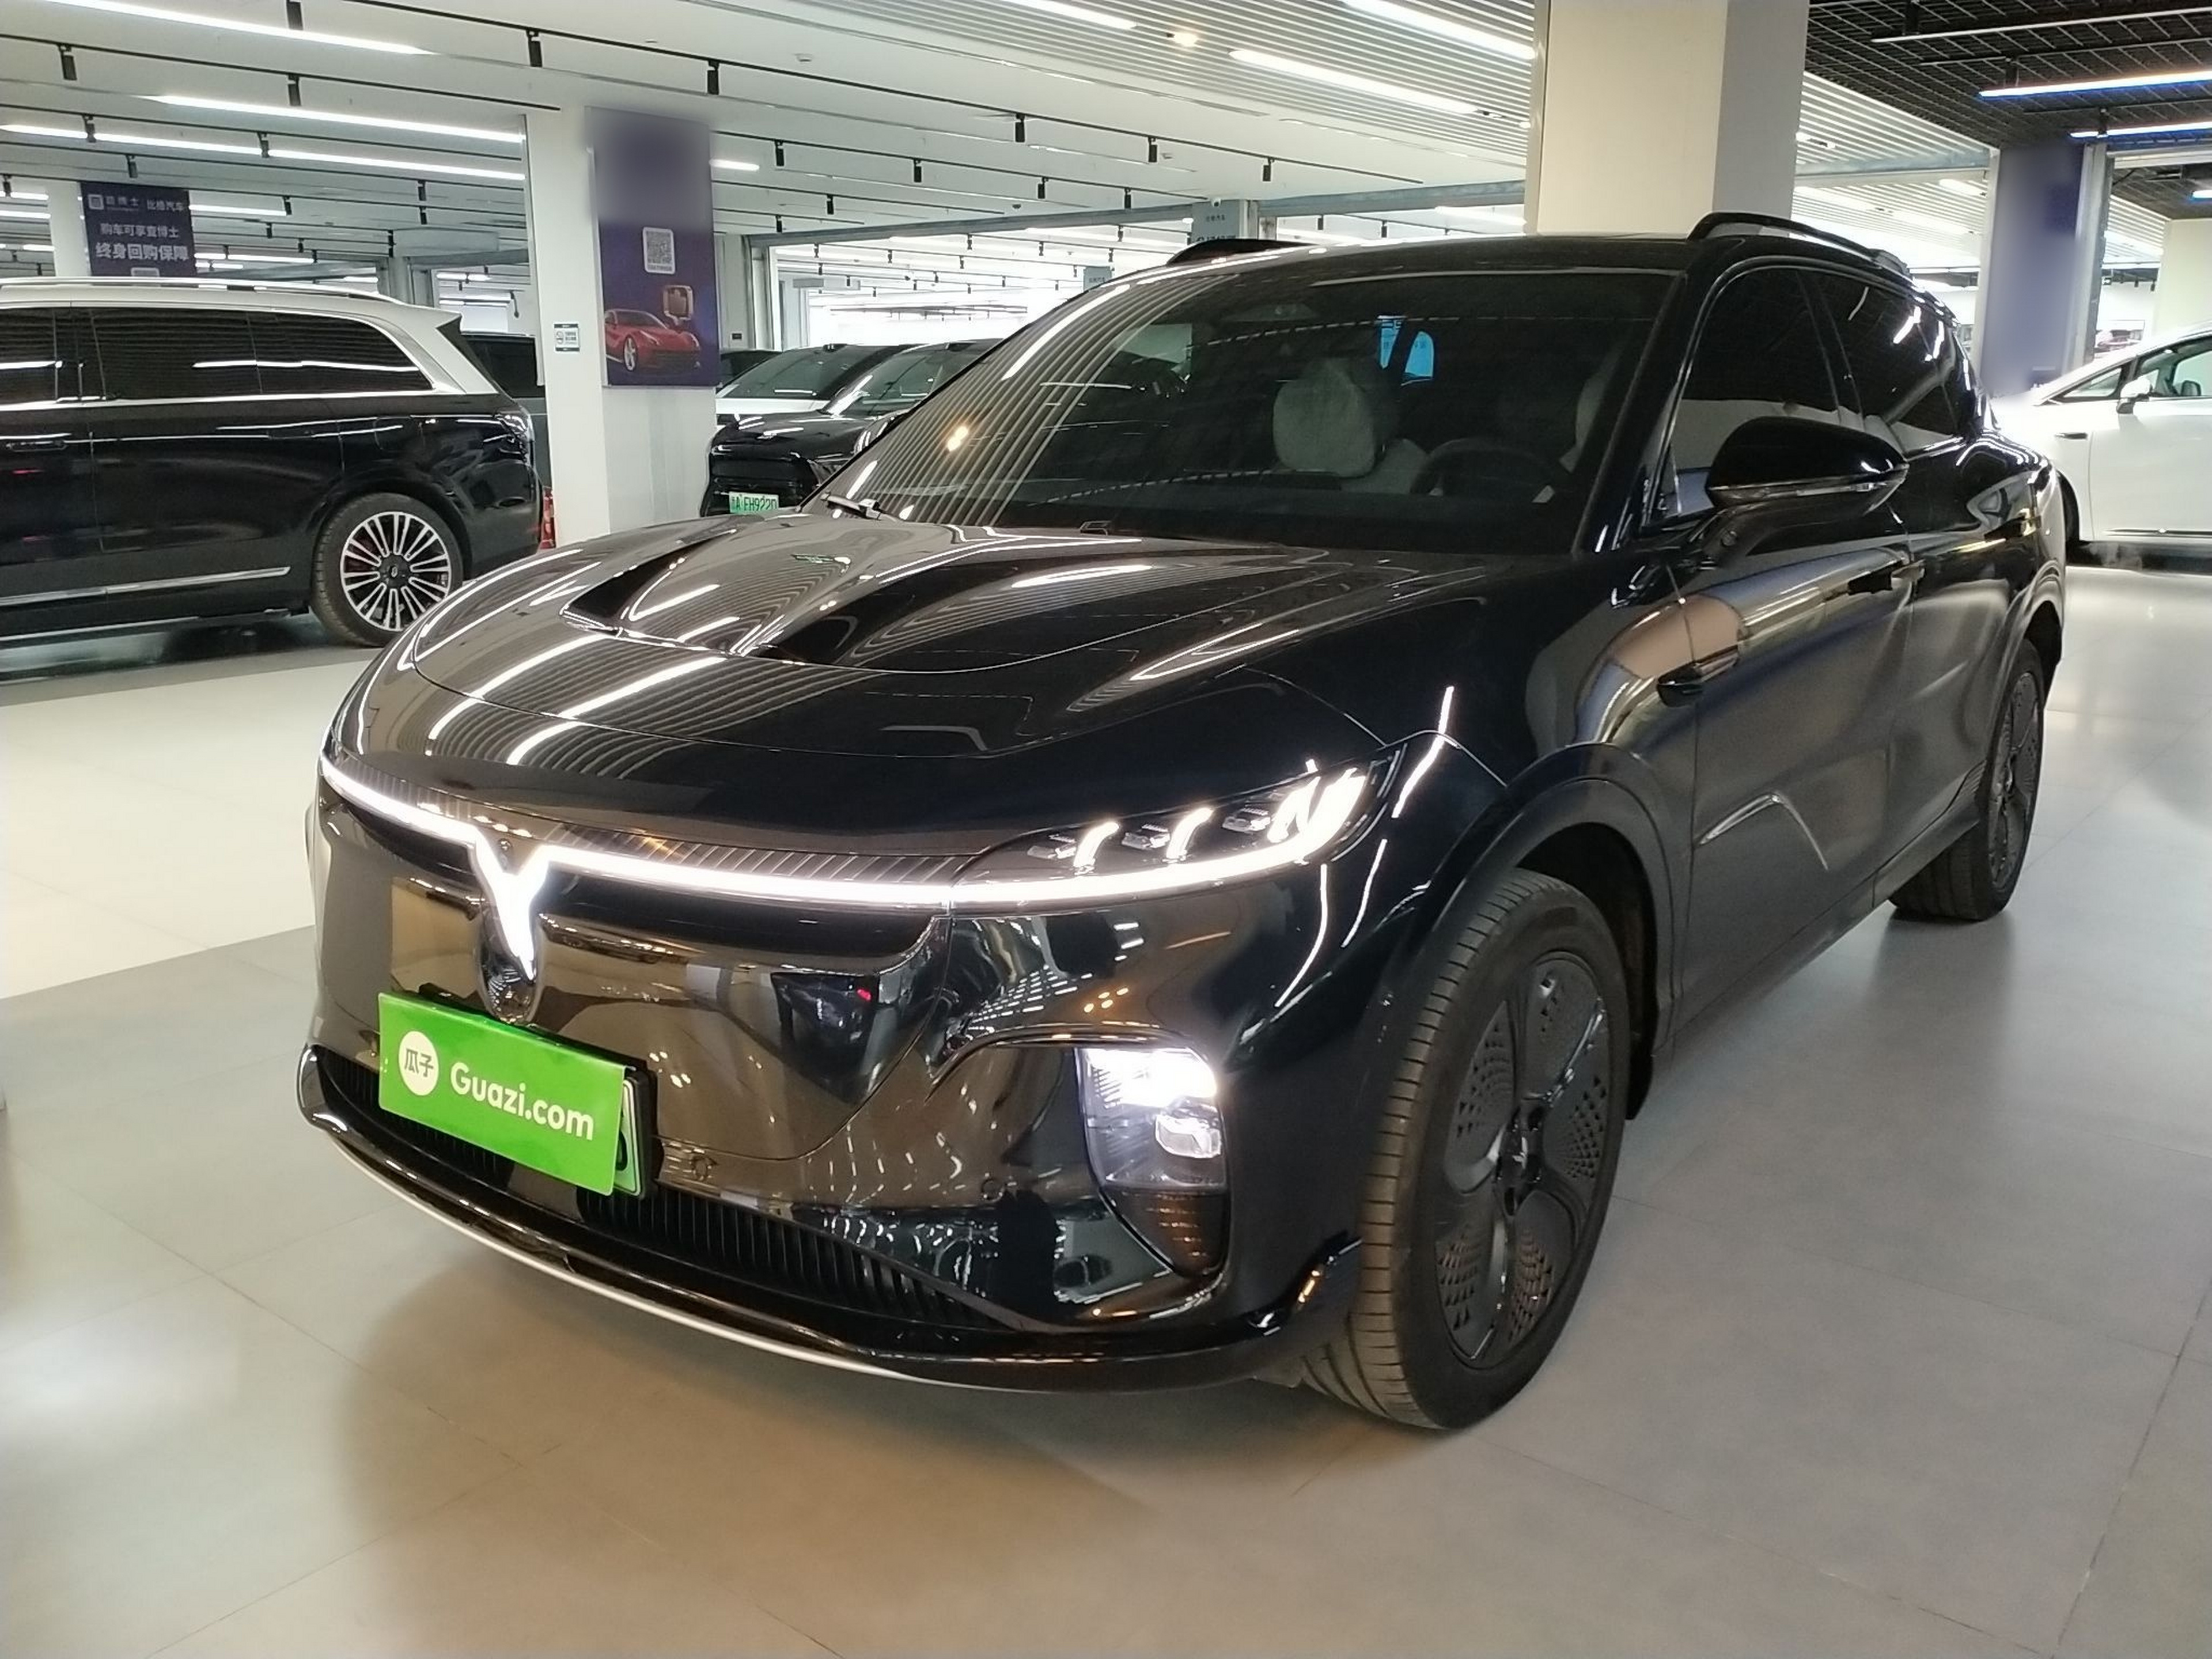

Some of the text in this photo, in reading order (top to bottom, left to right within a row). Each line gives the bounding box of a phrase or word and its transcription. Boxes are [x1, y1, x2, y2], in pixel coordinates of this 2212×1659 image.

[96, 242, 189, 261] 终身回购保障
[404, 1048, 435, 1078] 瓜子
[450, 1061, 594, 1141] Guazi.com
